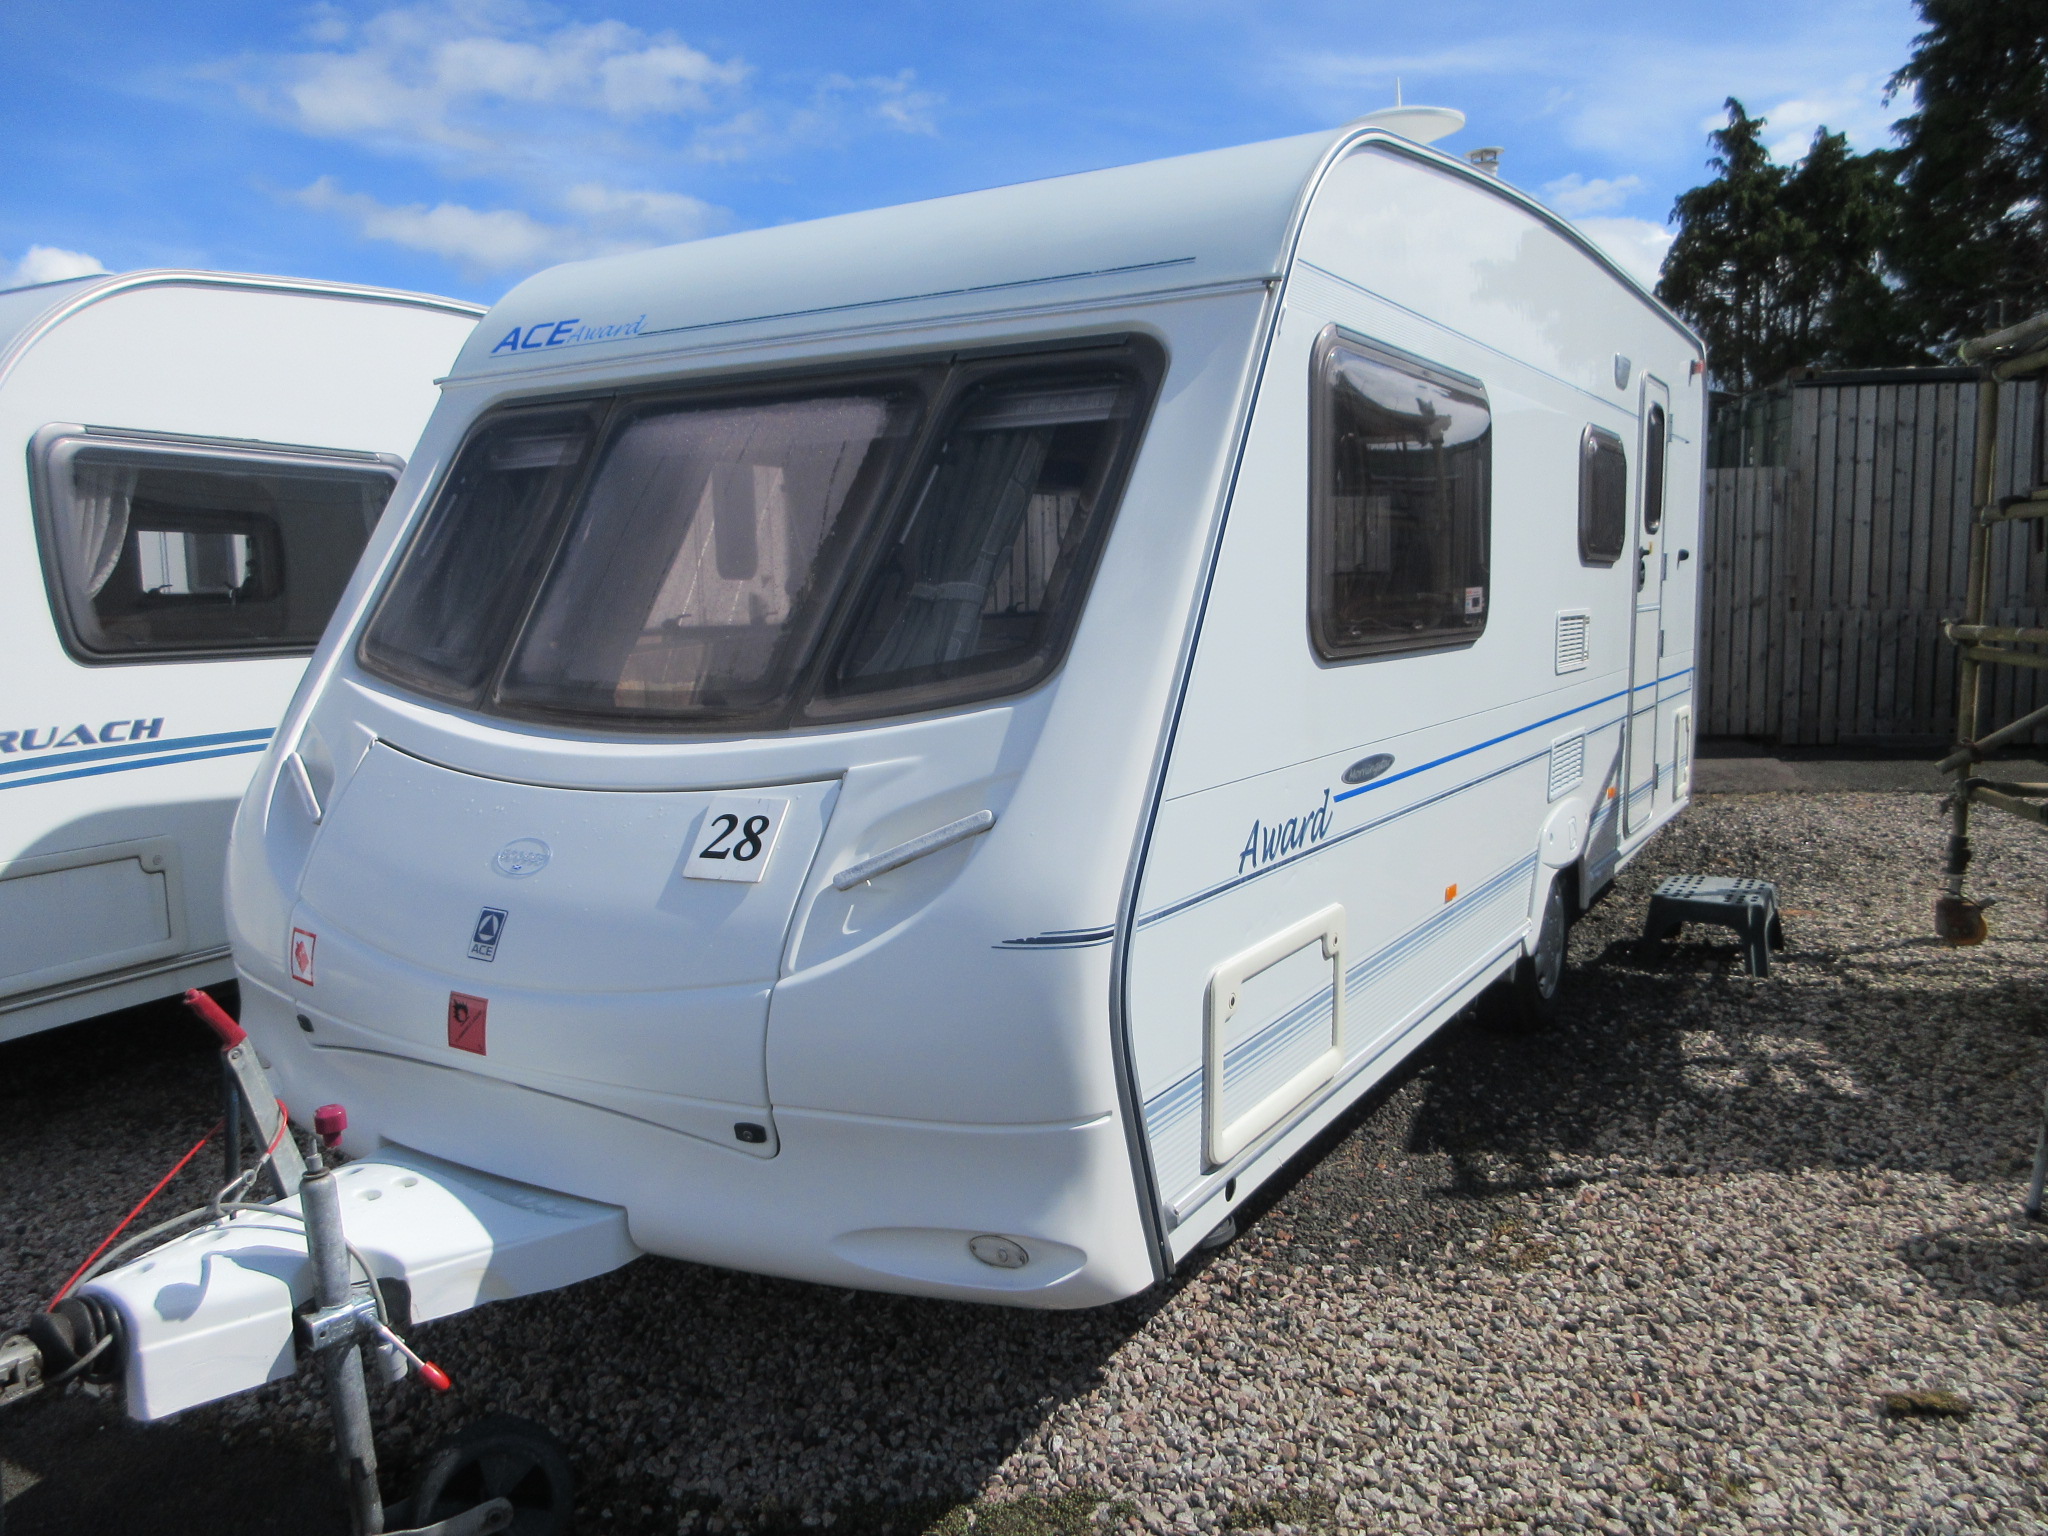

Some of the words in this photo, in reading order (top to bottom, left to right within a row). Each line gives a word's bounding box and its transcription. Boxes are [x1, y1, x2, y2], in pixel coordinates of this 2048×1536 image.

[491, 318, 580, 354] ACE
[567, 314, 648, 343] Award
[0, 717, 165, 753] RUACH
[699, 813, 770, 861] 28
[1238, 787, 1333, 875] Award
[471, 943, 493, 957] ACE
